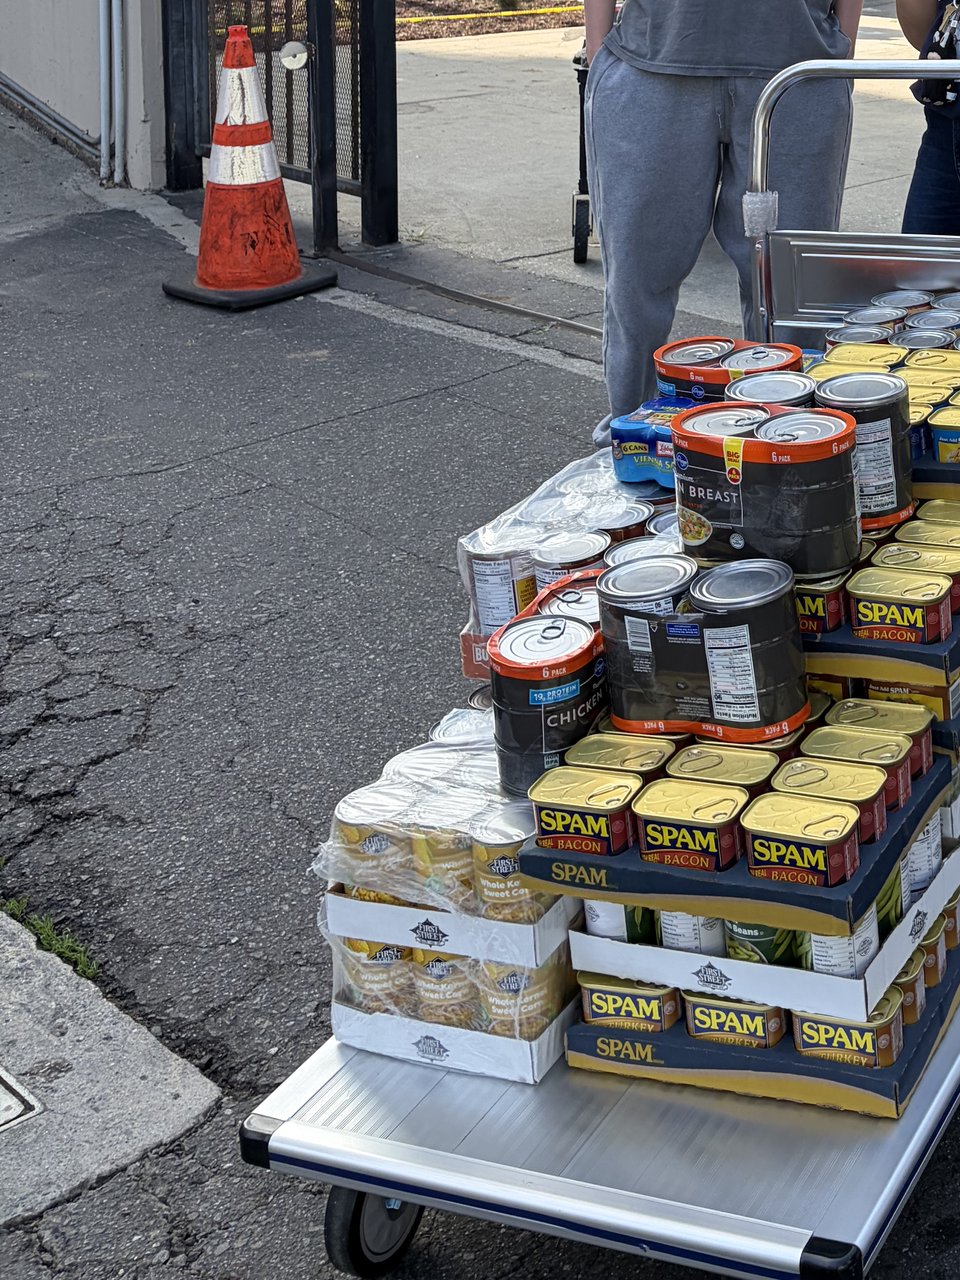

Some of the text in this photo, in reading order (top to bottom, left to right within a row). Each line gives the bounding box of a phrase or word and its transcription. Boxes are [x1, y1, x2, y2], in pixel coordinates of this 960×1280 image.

[622, 444, 648, 454] 6 CANS
[832, 441, 851, 454] 6 PACK
[726, 450, 741, 459] BIG
[771, 452, 791, 463] 6 PACK
[633, 456, 663, 468] VIENNA
[728, 473, 741, 481] PACK
[689, 485, 739, 504] BREAST
[857, 601, 925, 628] SPAM
[873, 630, 917, 643] BACON
[475, 647, 489, 661] BU
[542, 666, 567, 678] 6 PACK
[547, 684, 577, 699] PROTEIN
[890, 686, 909, 695] SPAM
[546, 690, 604, 728] CHICKEN
[658, 722, 665, 732] 6
[701, 724, 723, 737] 6 PACK
[764, 721, 789, 735] 6 PACK
[539, 810, 610, 838] SPAM
[645, 823, 718, 853] SPAM
[557, 839, 602, 853] BACON
[664, 853, 710, 869] BACON
[753, 839, 827, 871] SPAM
[491, 864, 520, 875] STREET
[494, 858, 516, 868] FIRST
[551, 863, 608, 888] SPAM
[771, 870, 818, 886] BACON
[480, 878, 505, 889] Whole
[483, 888, 510, 898] Sweet
[418, 921, 439, 932] FIRST
[733, 923, 760, 936] Beans
[416, 930, 443, 942] STREET
[376, 948, 400, 960] FIRST
[701, 967, 723, 977] FIRST
[698, 974, 727, 985] STREET
[591, 992, 661, 1020] SPAM
[694, 1007, 766, 1037] SPAM
[420, 1037, 441, 1048] FIRST
[802, 1022, 875, 1053] SPAM
[417, 1045, 445, 1057] STREET
[596, 1038, 654, 1063] SPAM
